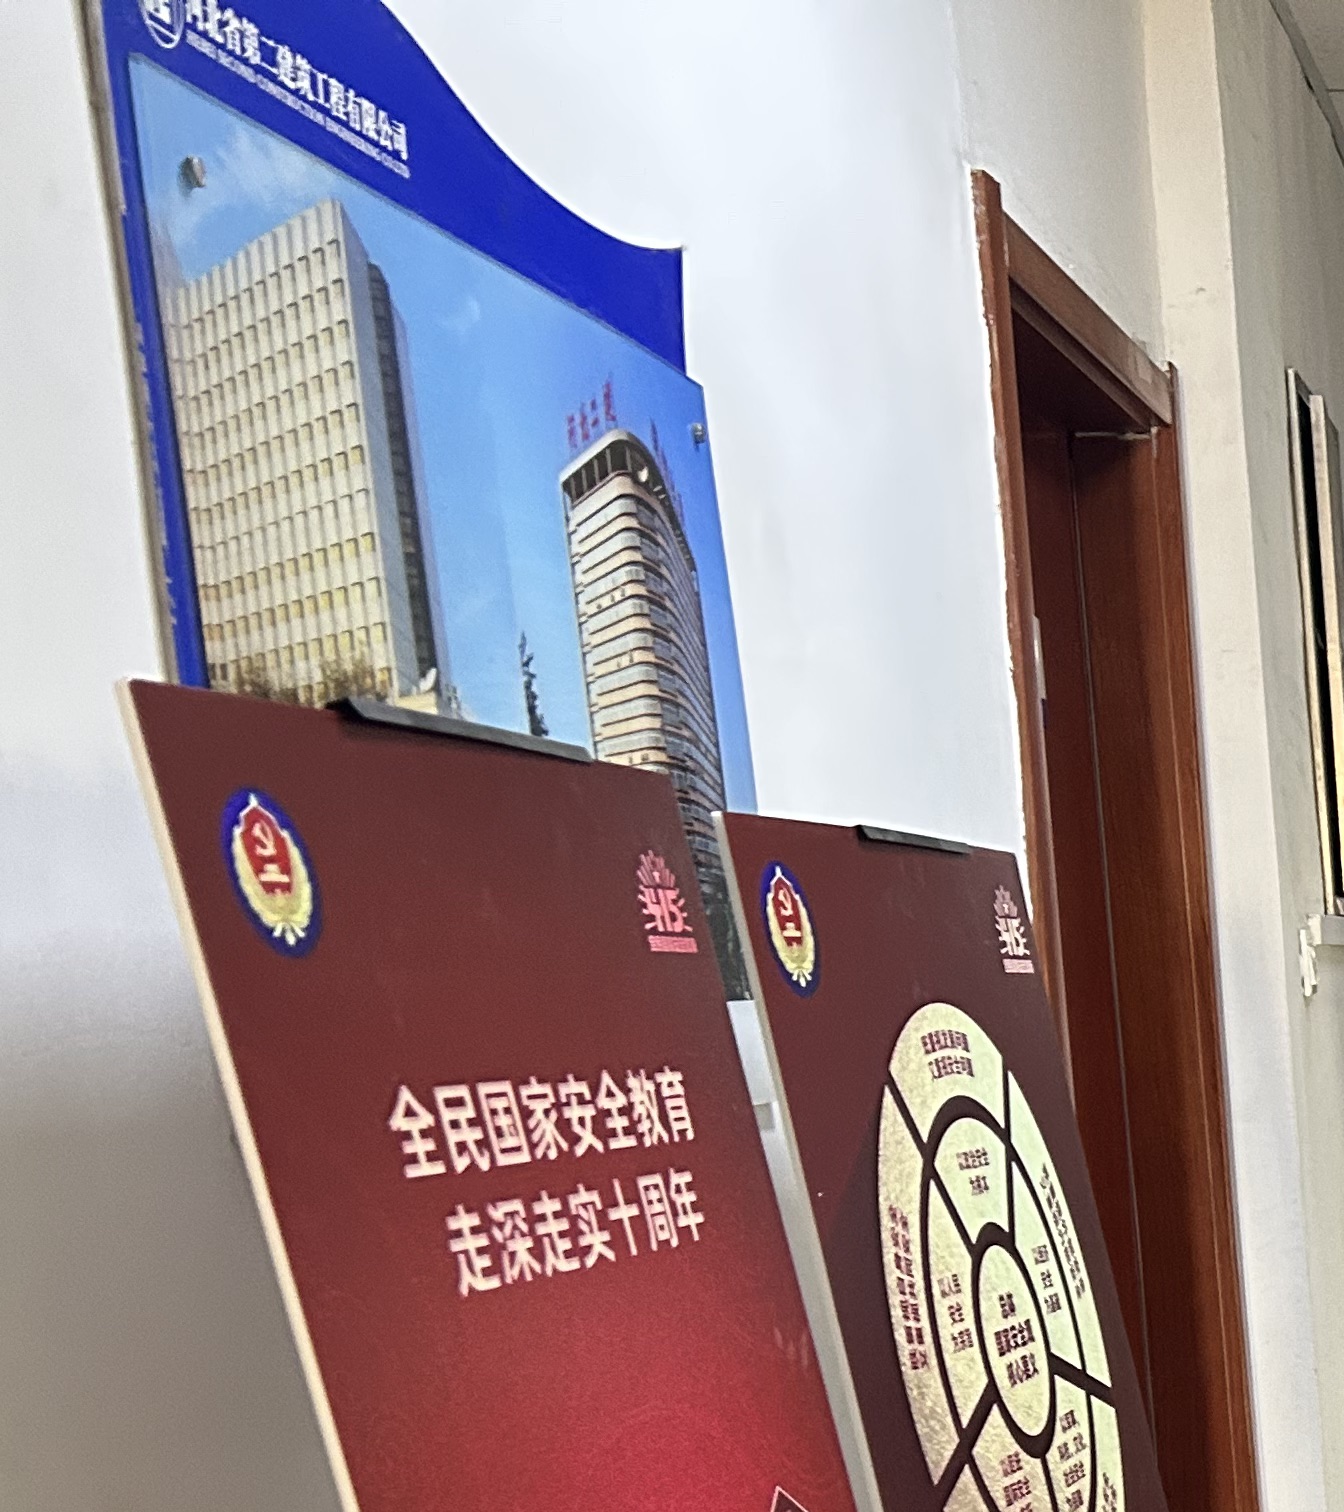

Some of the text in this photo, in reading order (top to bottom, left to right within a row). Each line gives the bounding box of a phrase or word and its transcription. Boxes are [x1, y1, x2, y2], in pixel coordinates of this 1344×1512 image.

[388, 1066, 694, 1178] 全民国家安全教育
[446, 1168, 705, 1297] 走深走实十周年
